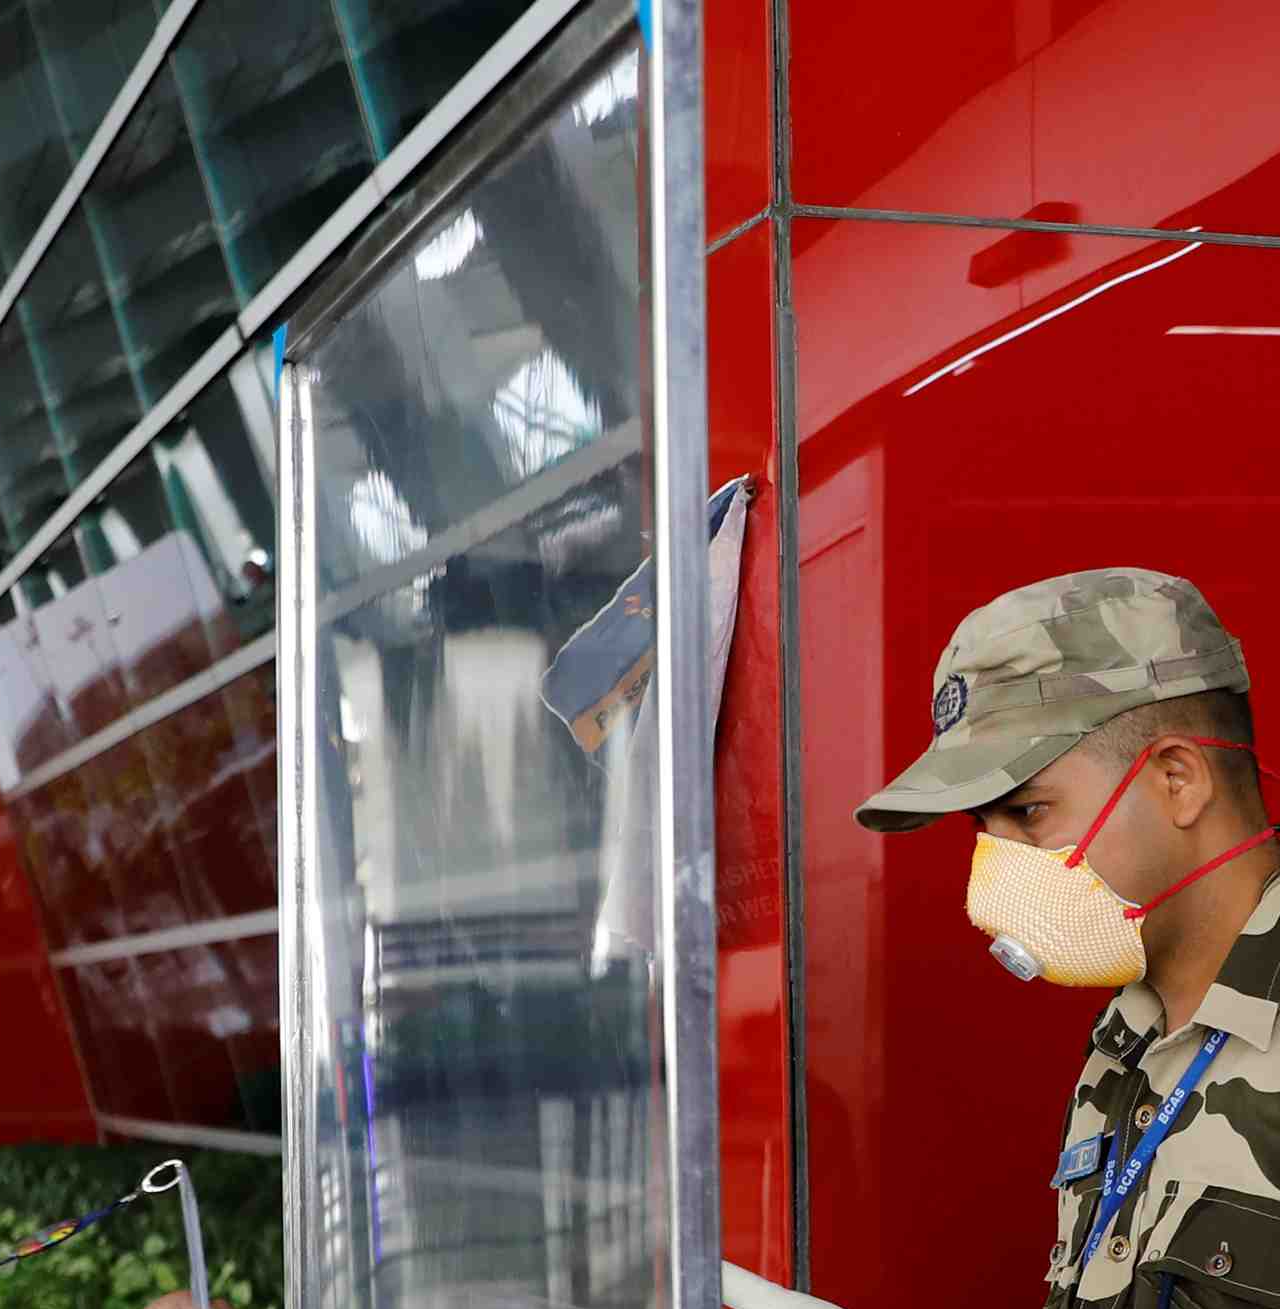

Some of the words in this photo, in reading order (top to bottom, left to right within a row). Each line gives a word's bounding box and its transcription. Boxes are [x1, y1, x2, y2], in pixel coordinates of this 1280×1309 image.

[1157, 1087, 1185, 1125] BCAS
[1103, 1159, 1116, 1197] BCAS
[1116, 1158, 1142, 1196] BCAS
